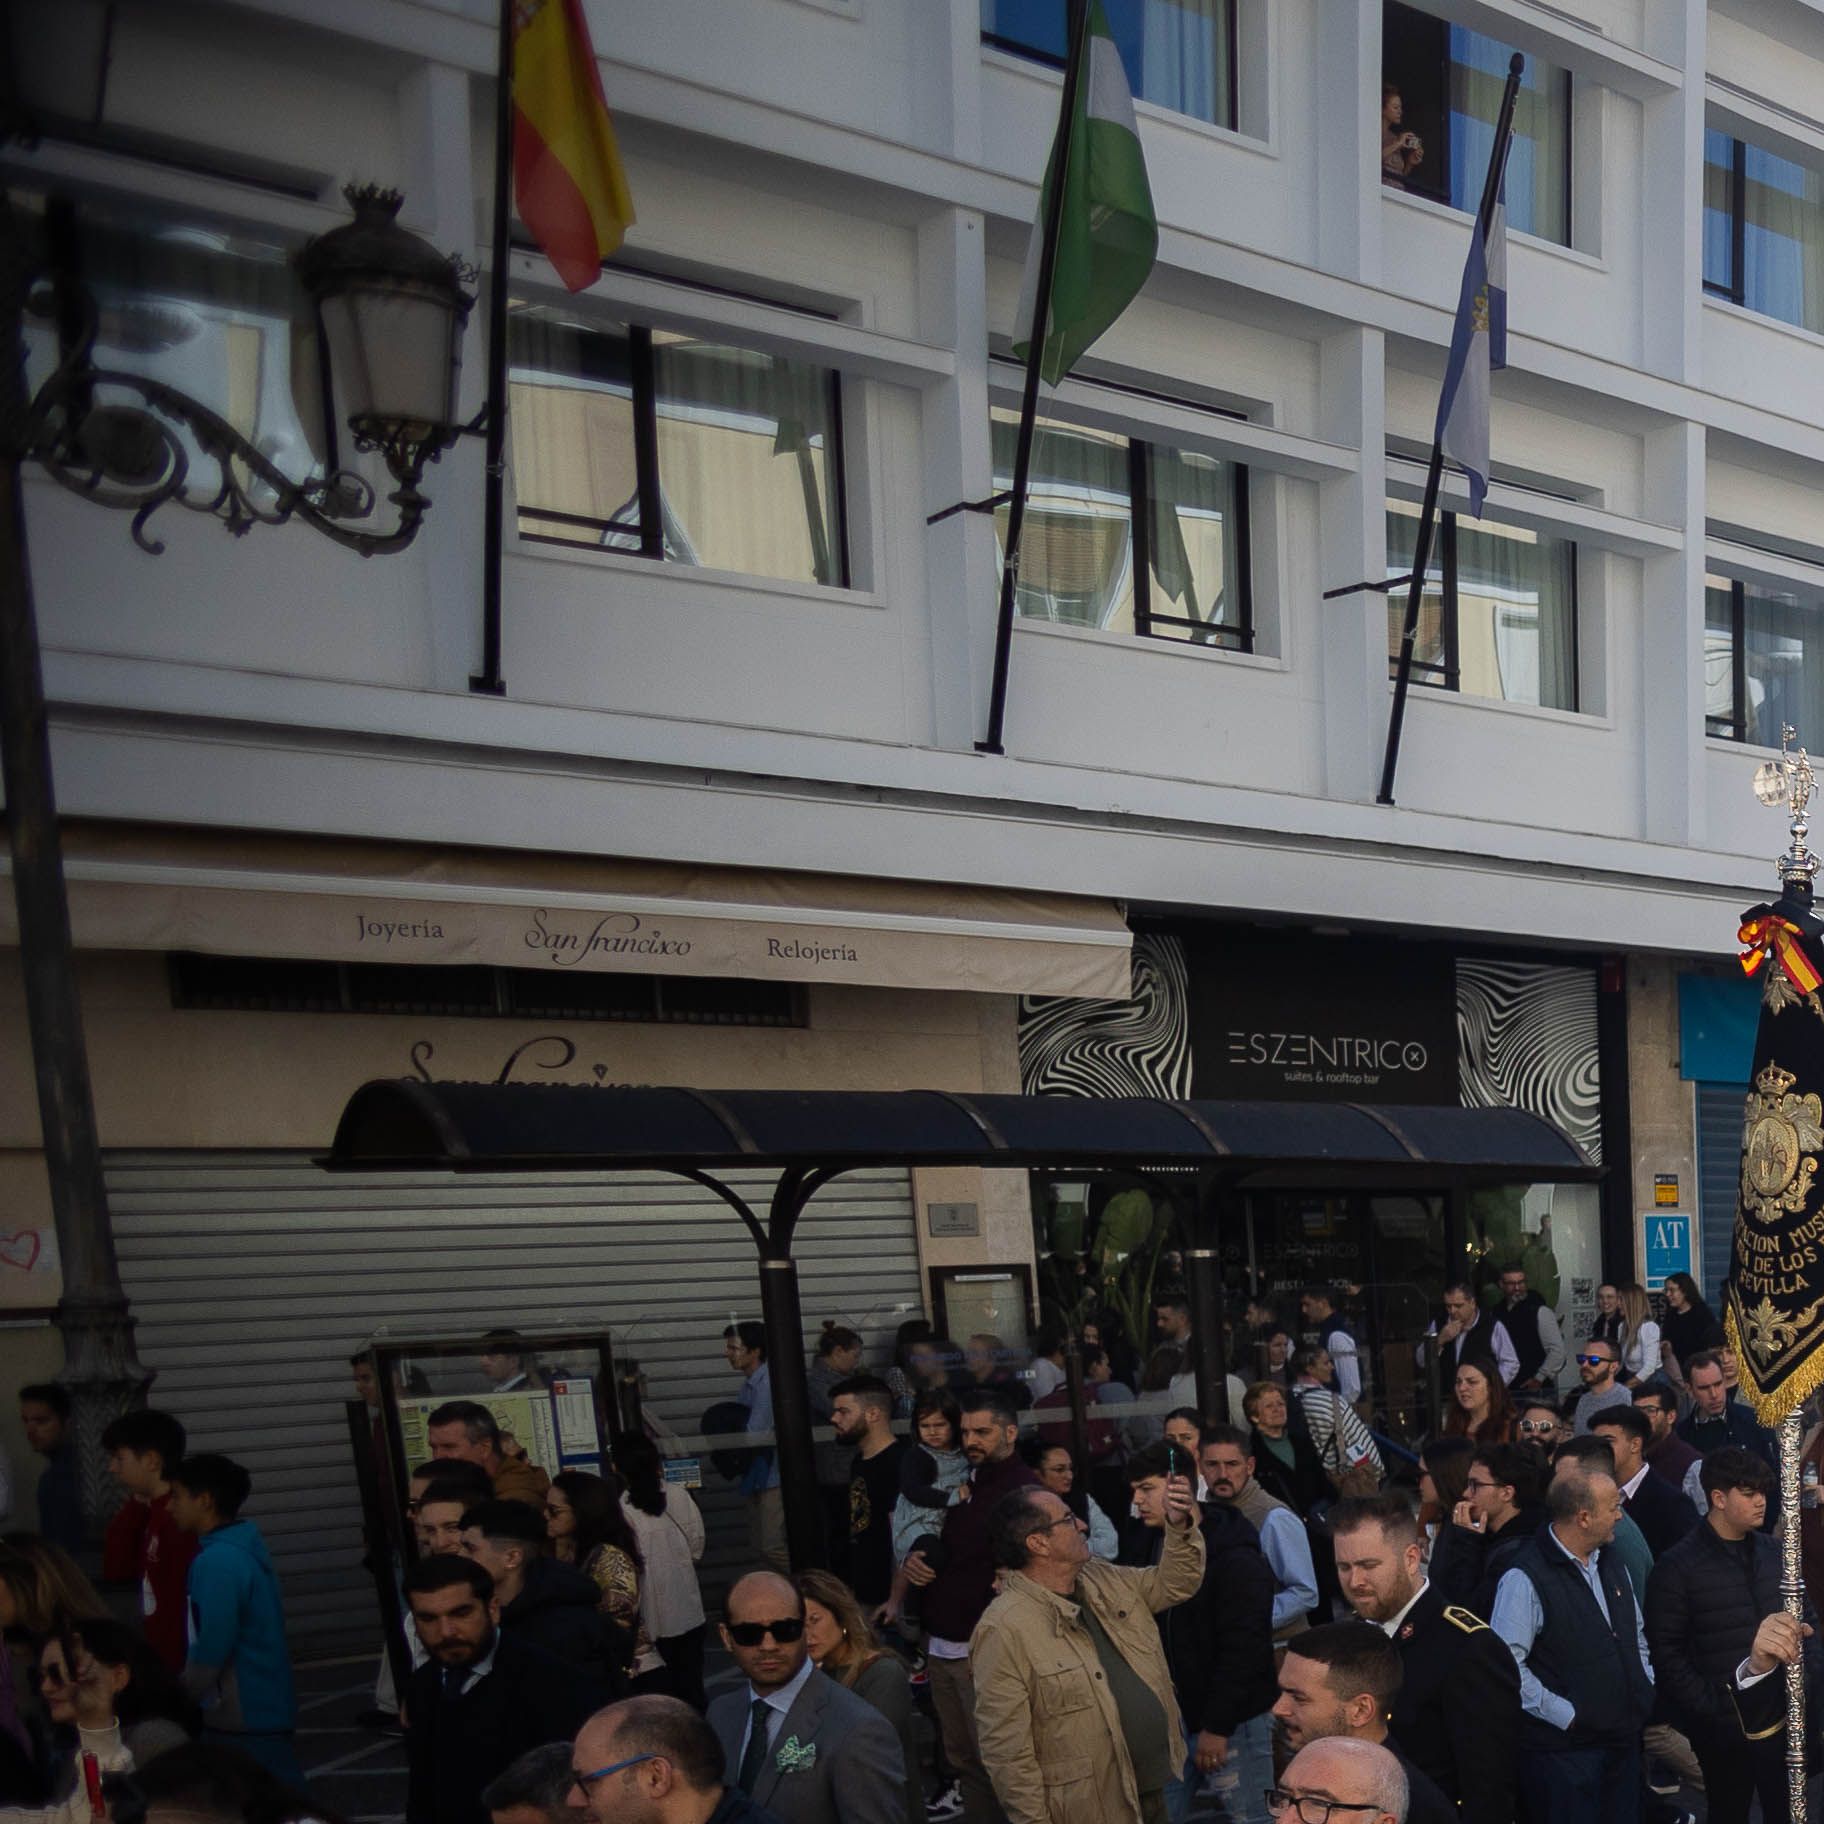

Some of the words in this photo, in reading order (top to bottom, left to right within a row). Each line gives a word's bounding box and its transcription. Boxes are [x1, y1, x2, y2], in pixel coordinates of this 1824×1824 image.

[356, 914, 445, 942] Joyería
[524, 908, 579, 950] San
[767, 938, 858, 964] Relojería
[1227, 1031, 1428, 1072] ESZENTRICO
[1283, 1071, 1313, 1083] suites
[1315, 1071, 1325, 1083] &
[1326, 1072, 1363, 1086] rooftop
[1364, 1073, 1381, 1085] bar
[1652, 1220, 1685, 1250] AT
[1753, 1256, 1775, 1275] DE
[1779, 1246, 1818, 1273] LOS
